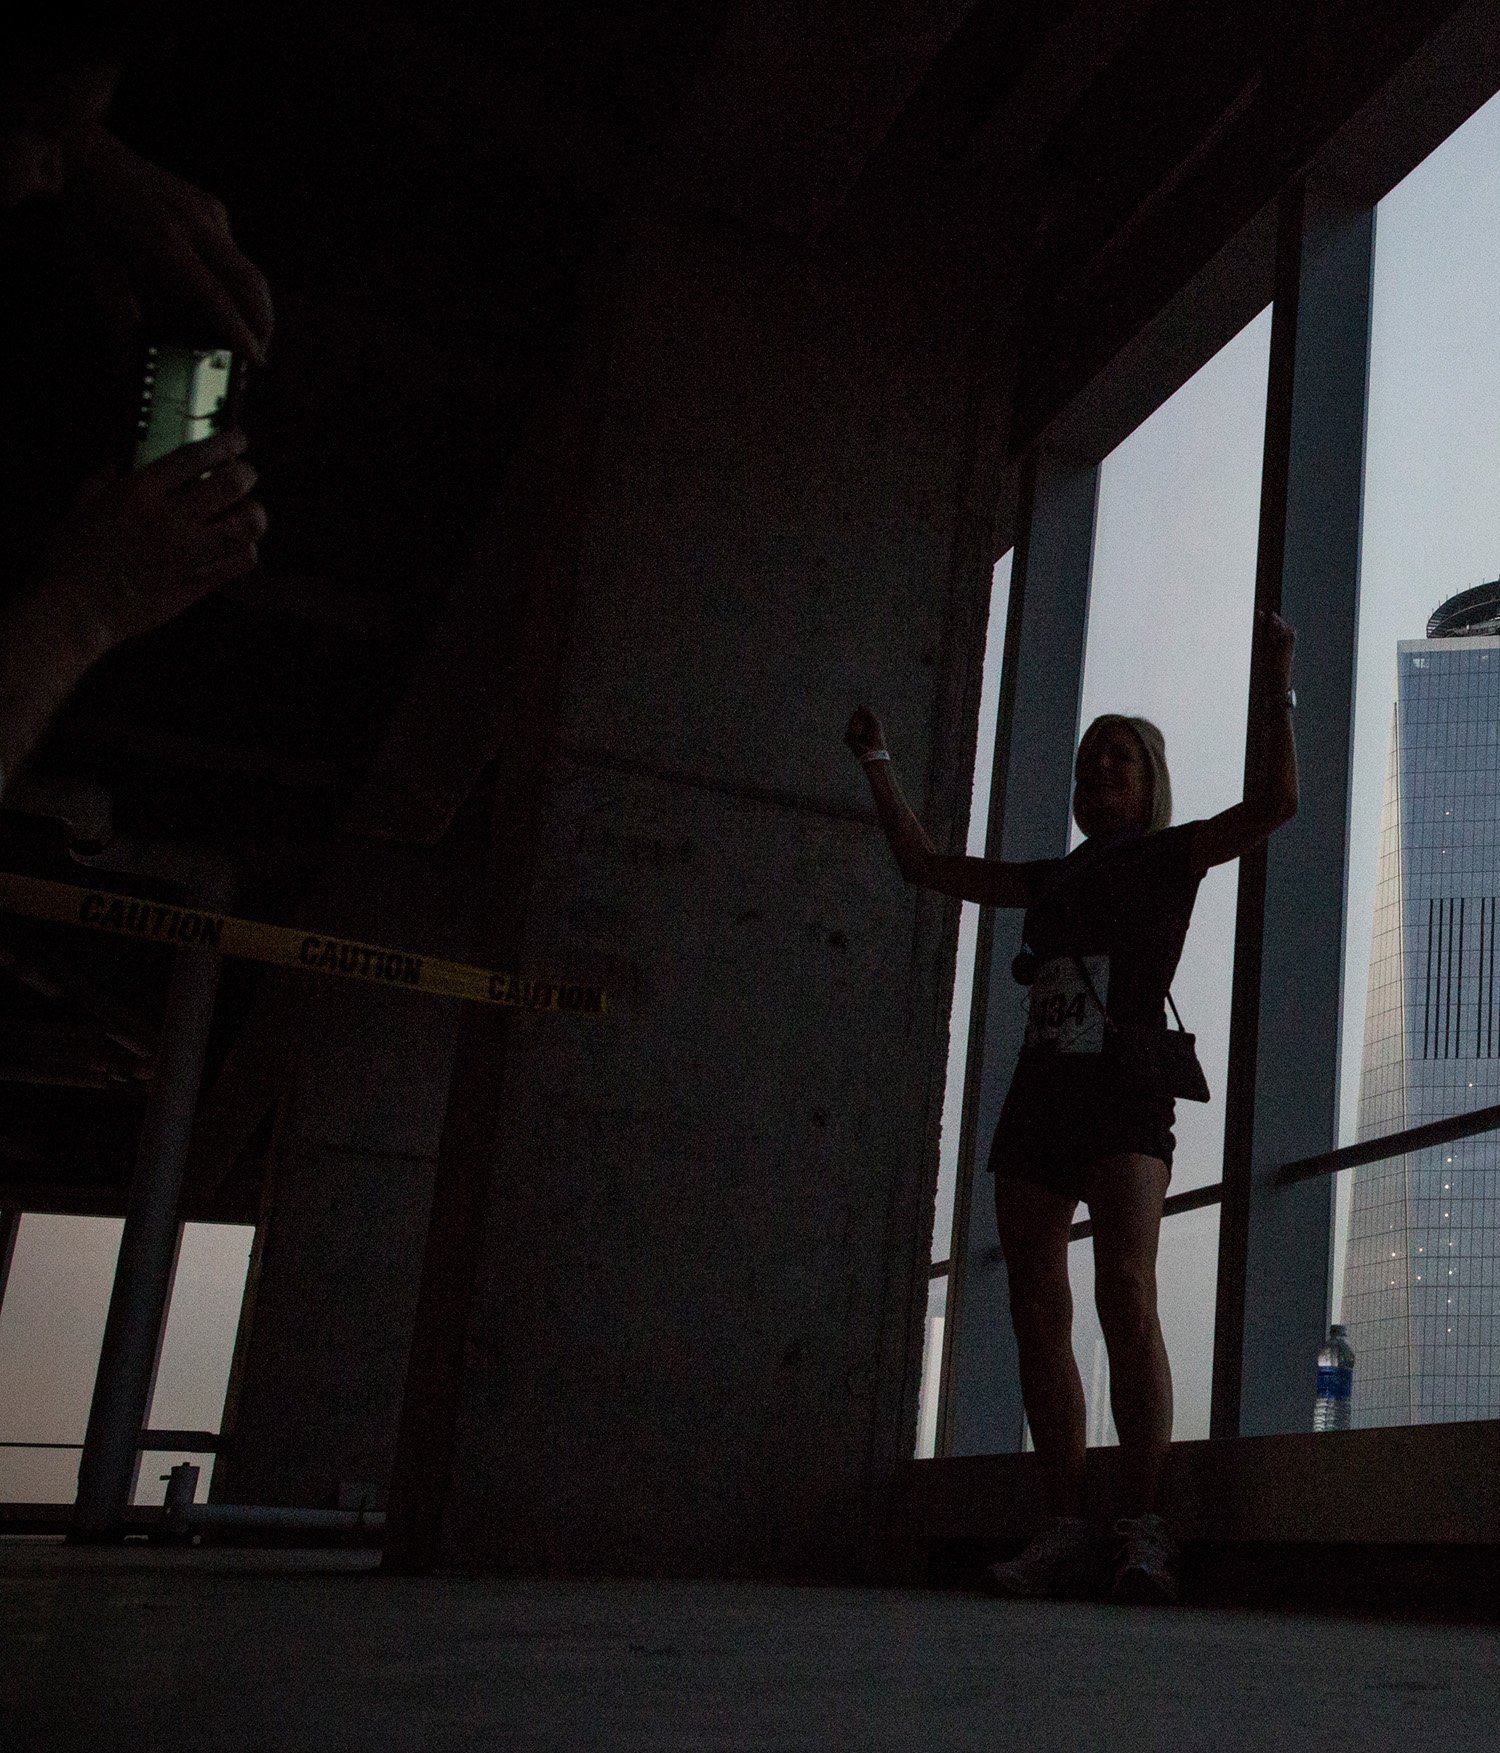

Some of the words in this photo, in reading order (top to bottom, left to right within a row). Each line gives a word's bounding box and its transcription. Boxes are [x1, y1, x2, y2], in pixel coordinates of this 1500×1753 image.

[79, 895, 224, 946] CAUTION
[299, 937, 421, 984] CAUTION
[488, 975, 603, 1012] CAUTION
